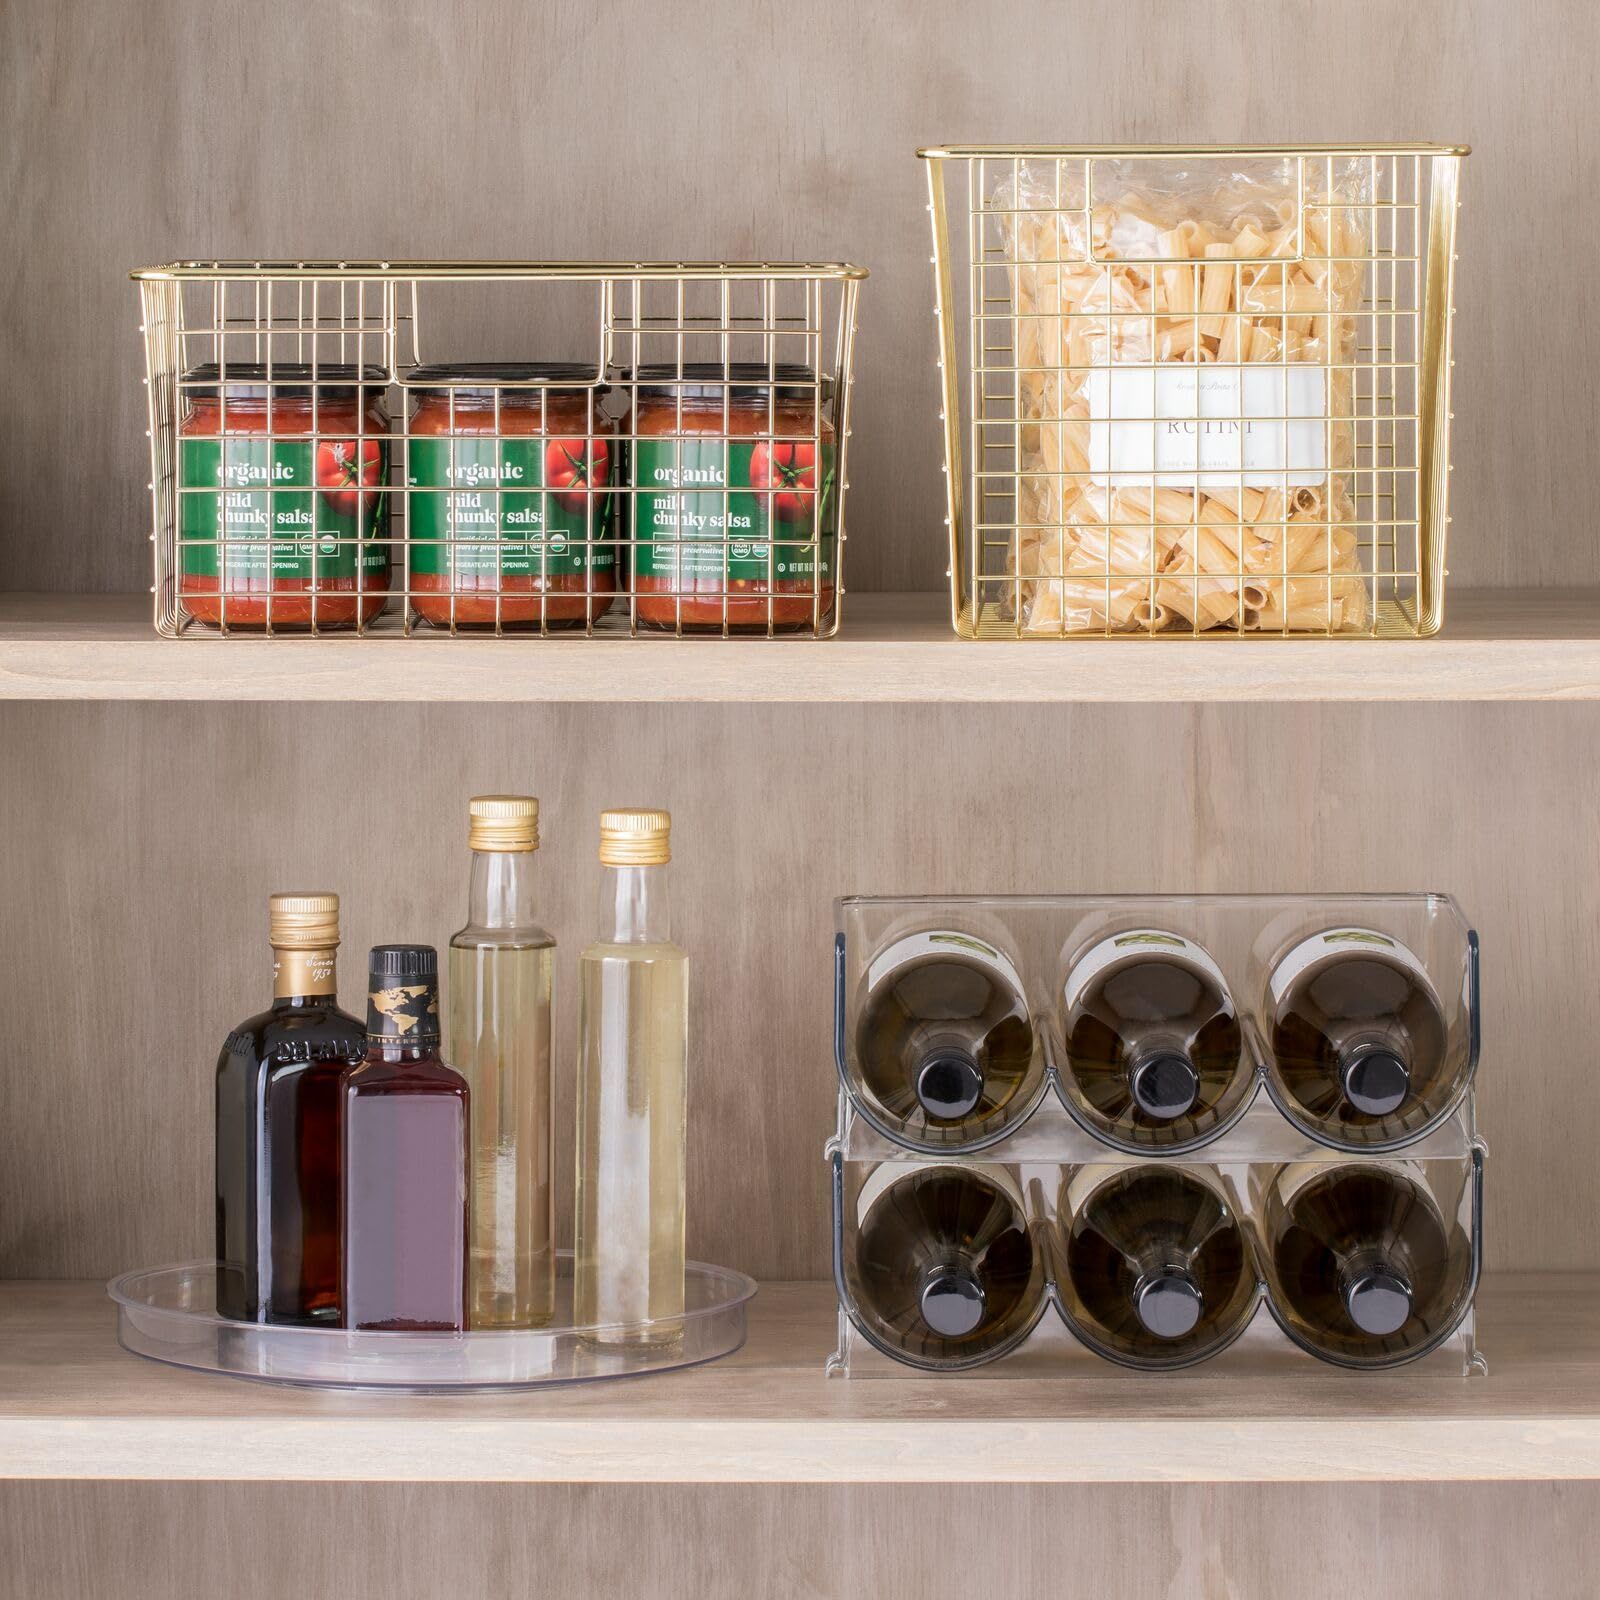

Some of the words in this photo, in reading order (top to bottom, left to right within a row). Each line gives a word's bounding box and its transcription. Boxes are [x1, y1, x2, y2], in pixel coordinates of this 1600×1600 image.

[216, 461, 294, 486] organic
[445, 461, 524, 486] organic
[653, 465, 726, 488] organic
[217, 508, 274, 528] chunky
[446, 508, 504, 527] chunky
[653, 511, 707, 530] chunky
[709, 512, 751, 528] salsa
